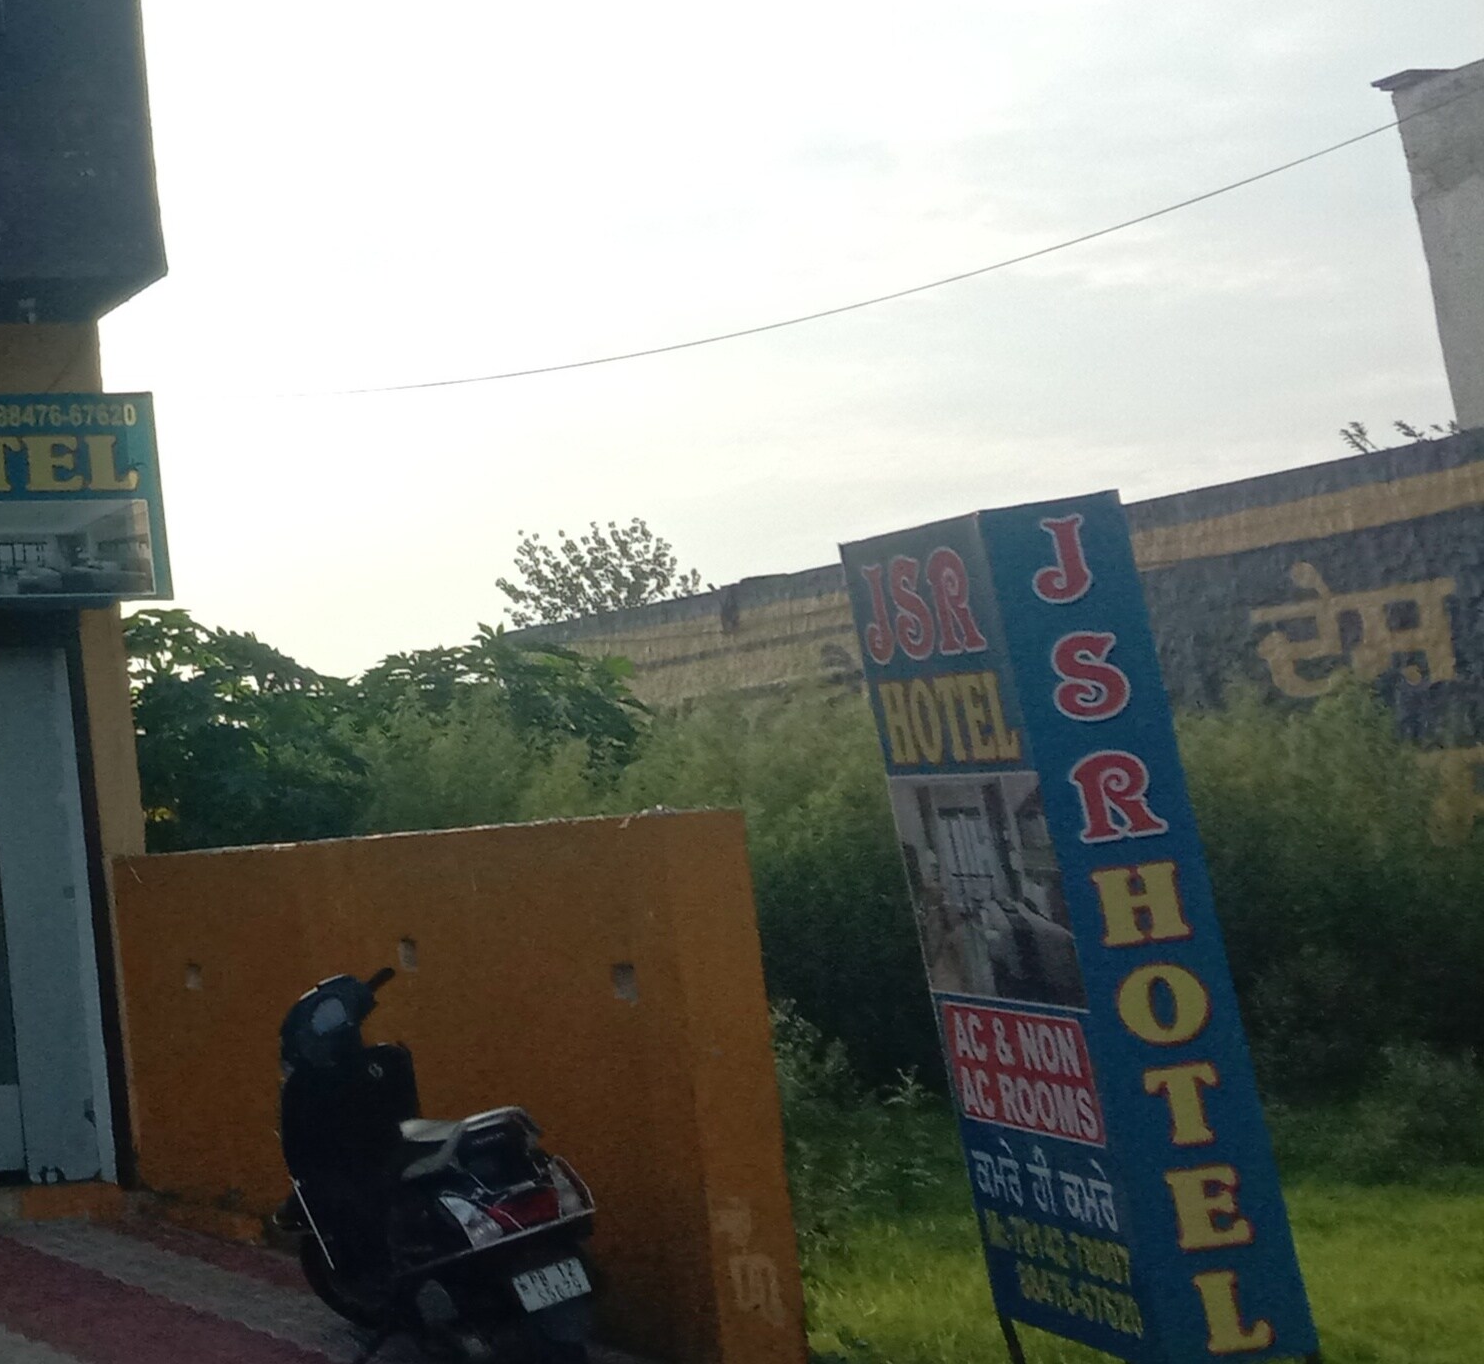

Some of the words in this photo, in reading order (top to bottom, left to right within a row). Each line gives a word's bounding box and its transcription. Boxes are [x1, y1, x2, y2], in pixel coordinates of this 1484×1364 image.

[861, 546, 987, 666] JSR
[878, 670, 1021, 764] HOTEL
[953, 1011, 989, 1063] AC
[992, 1017, 1015, 1066] &
[1017, 1020, 1083, 1078] NON
[960, 1065, 996, 1118] AC
[997, 1072, 1098, 1140] ROOMS
